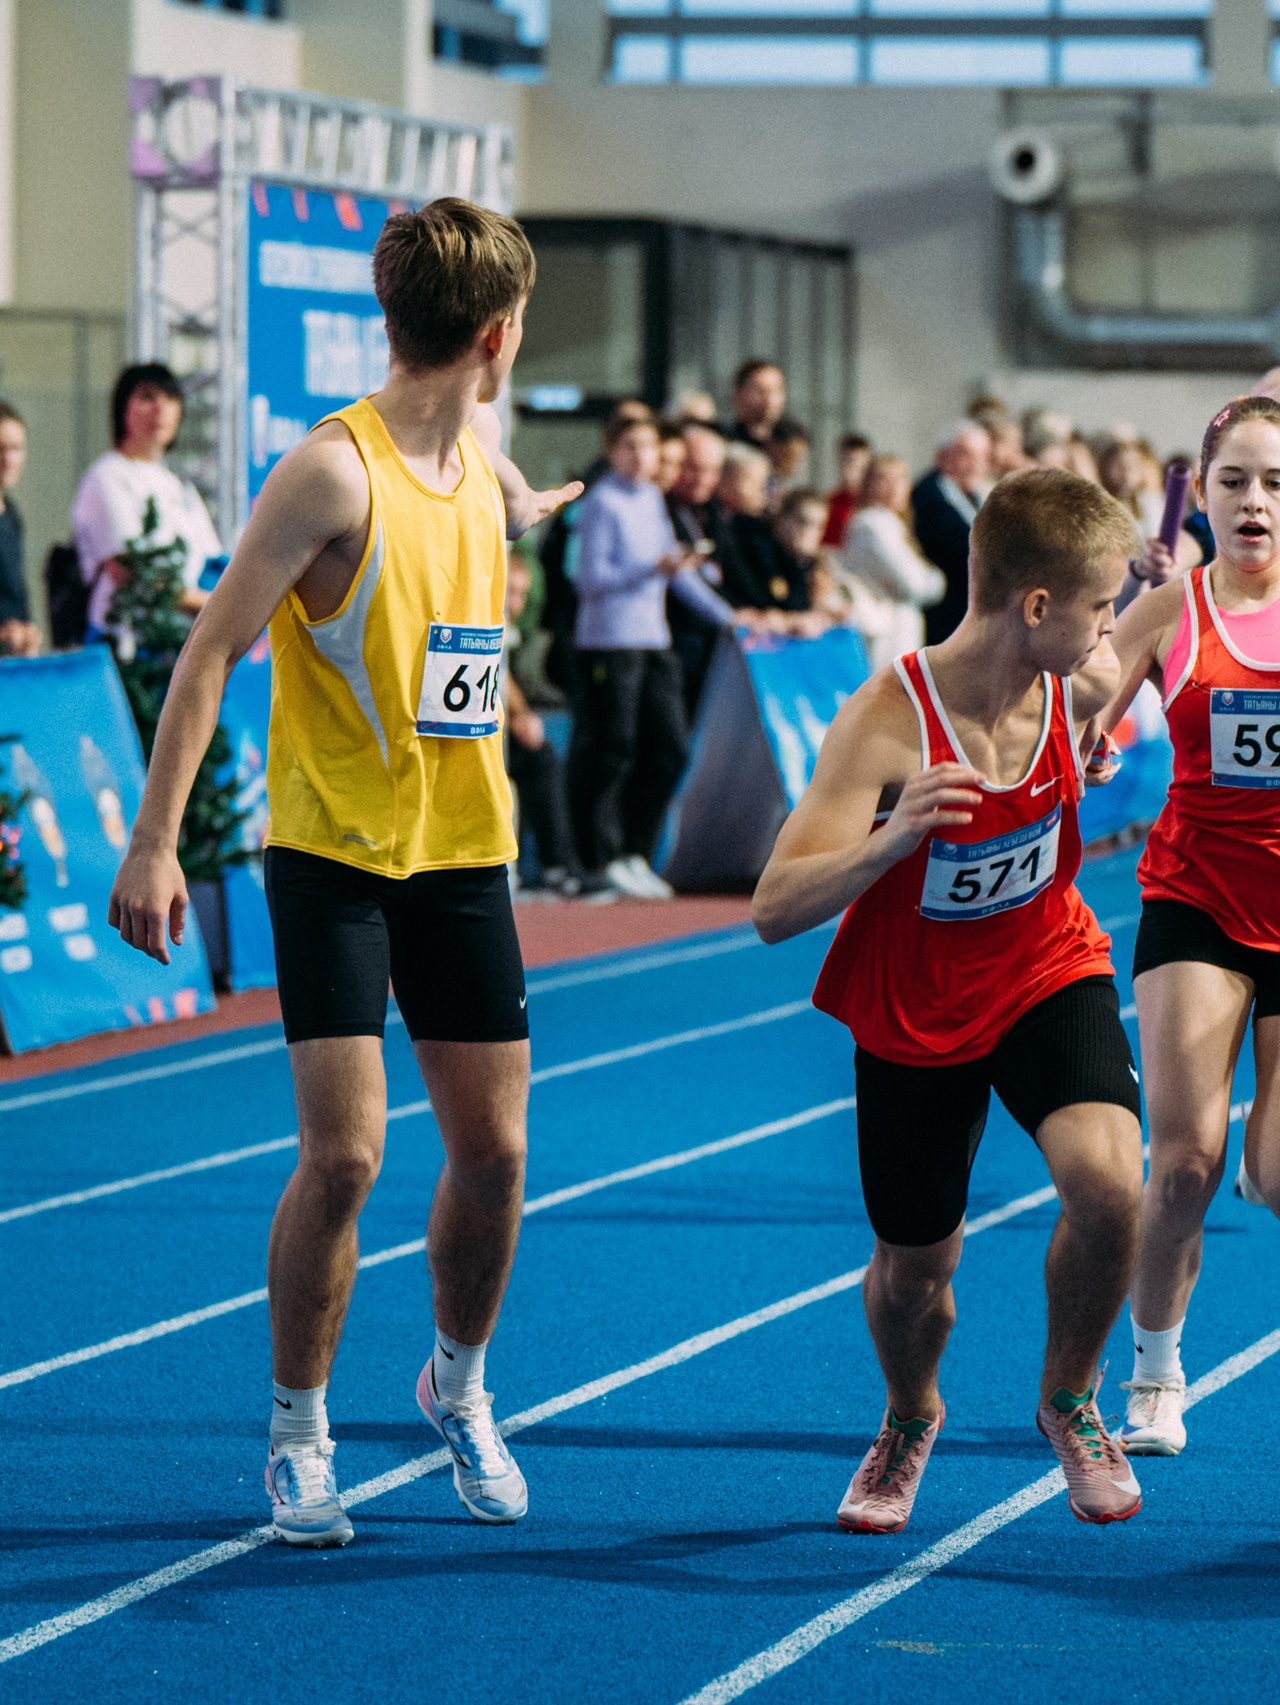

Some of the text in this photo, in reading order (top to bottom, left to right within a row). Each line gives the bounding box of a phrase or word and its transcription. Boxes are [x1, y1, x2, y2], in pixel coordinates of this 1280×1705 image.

[1243, 700, 1277, 711] ТАТЬЯНЫ
[967, 843, 1002, 859] ТАТЬЯНЫ
[1001, 826, 1042, 849] ЛЕБЕДЕВОЙ
[948, 846, 1041, 904] 571
